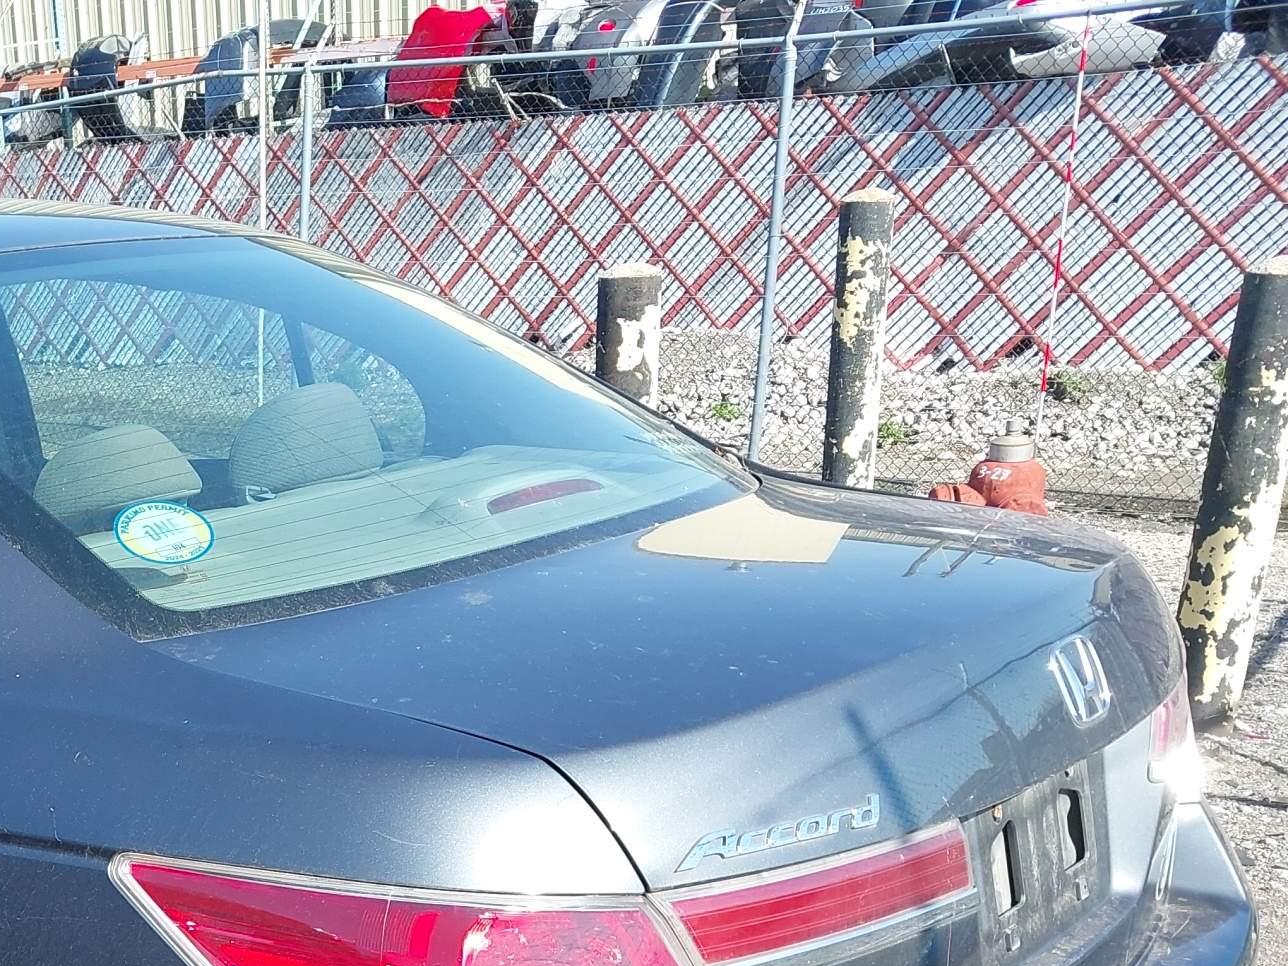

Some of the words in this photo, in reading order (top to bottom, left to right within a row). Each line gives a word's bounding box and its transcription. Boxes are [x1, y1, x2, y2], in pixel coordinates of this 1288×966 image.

[120, 506, 147, 534] PARKING
[148, 504, 190, 516] PERMIT
[673, 792, 880, 873] Accord
